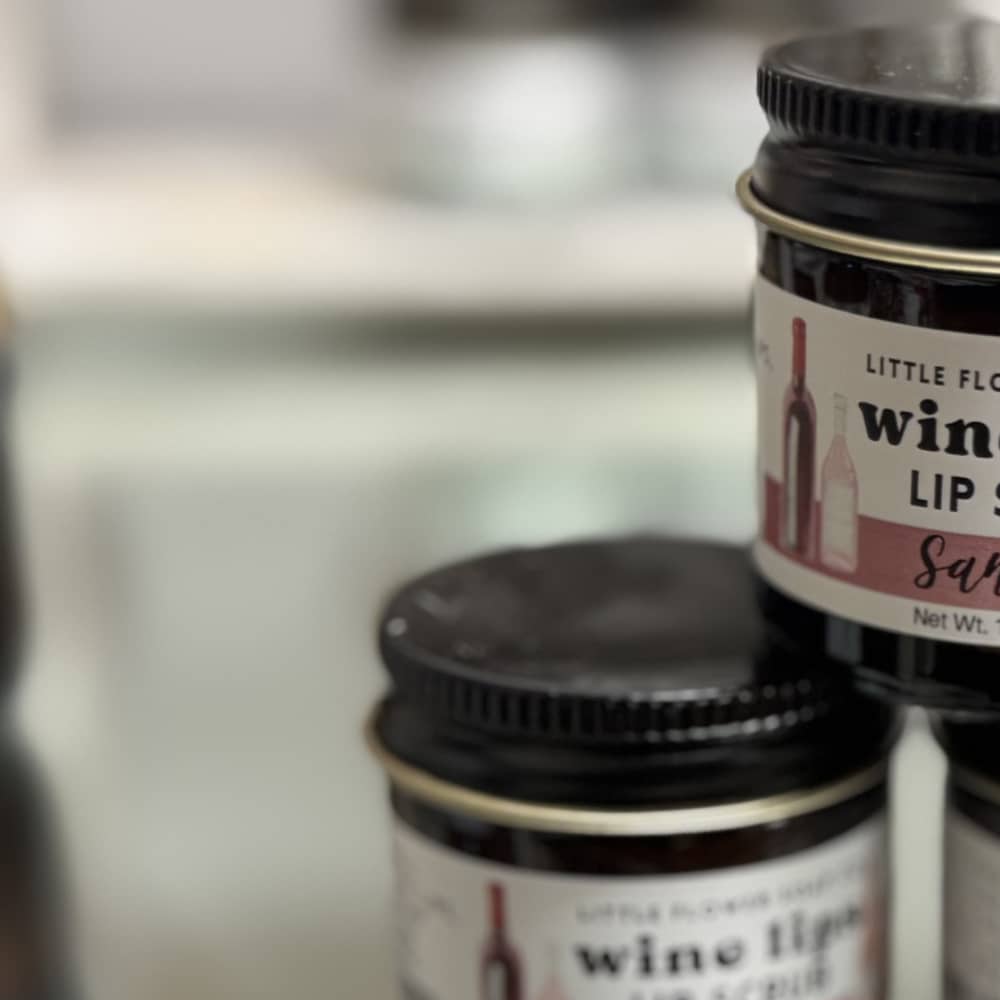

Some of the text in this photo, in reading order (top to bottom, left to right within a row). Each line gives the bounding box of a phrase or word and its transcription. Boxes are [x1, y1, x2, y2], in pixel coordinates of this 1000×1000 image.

[866, 353, 945, 386] LITTLE
[910, 469, 976, 513] LIP
[913, 606, 948, 630] Net
[953, 613, 988, 635] Wt.
[574, 932, 745, 978] wine
